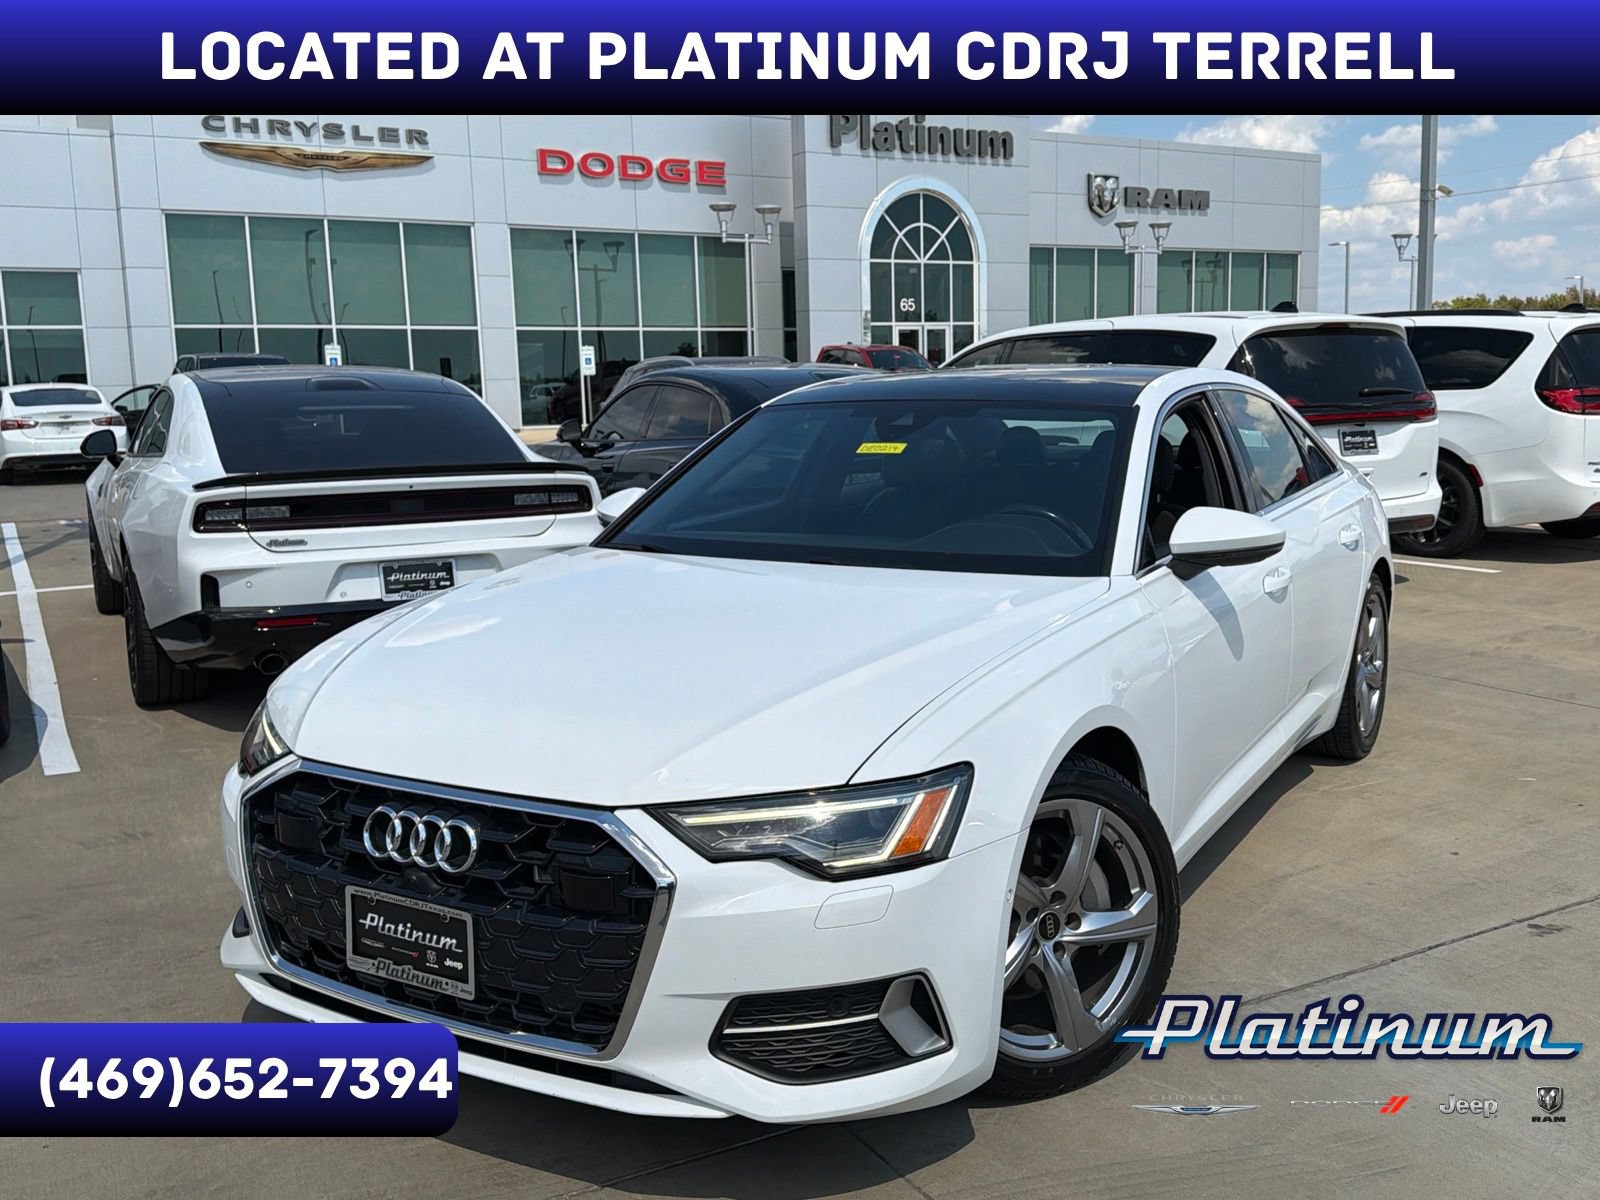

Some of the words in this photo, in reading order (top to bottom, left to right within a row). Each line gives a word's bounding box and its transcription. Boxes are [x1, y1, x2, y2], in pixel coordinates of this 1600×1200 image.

[201, 115, 429, 145] CHRYSLER
[829, 115, 1014, 160] Platinum
[536, 148, 727, 186] DODGE
[1124, 186, 1210, 211] RAM
[900, 298, 916, 312] 65
[386, 570, 451, 582] Platinum
[358, 912, 464, 953] Platinum
[373, 957, 449, 993] Platinum
[444, 957, 464, 971] Jeep
